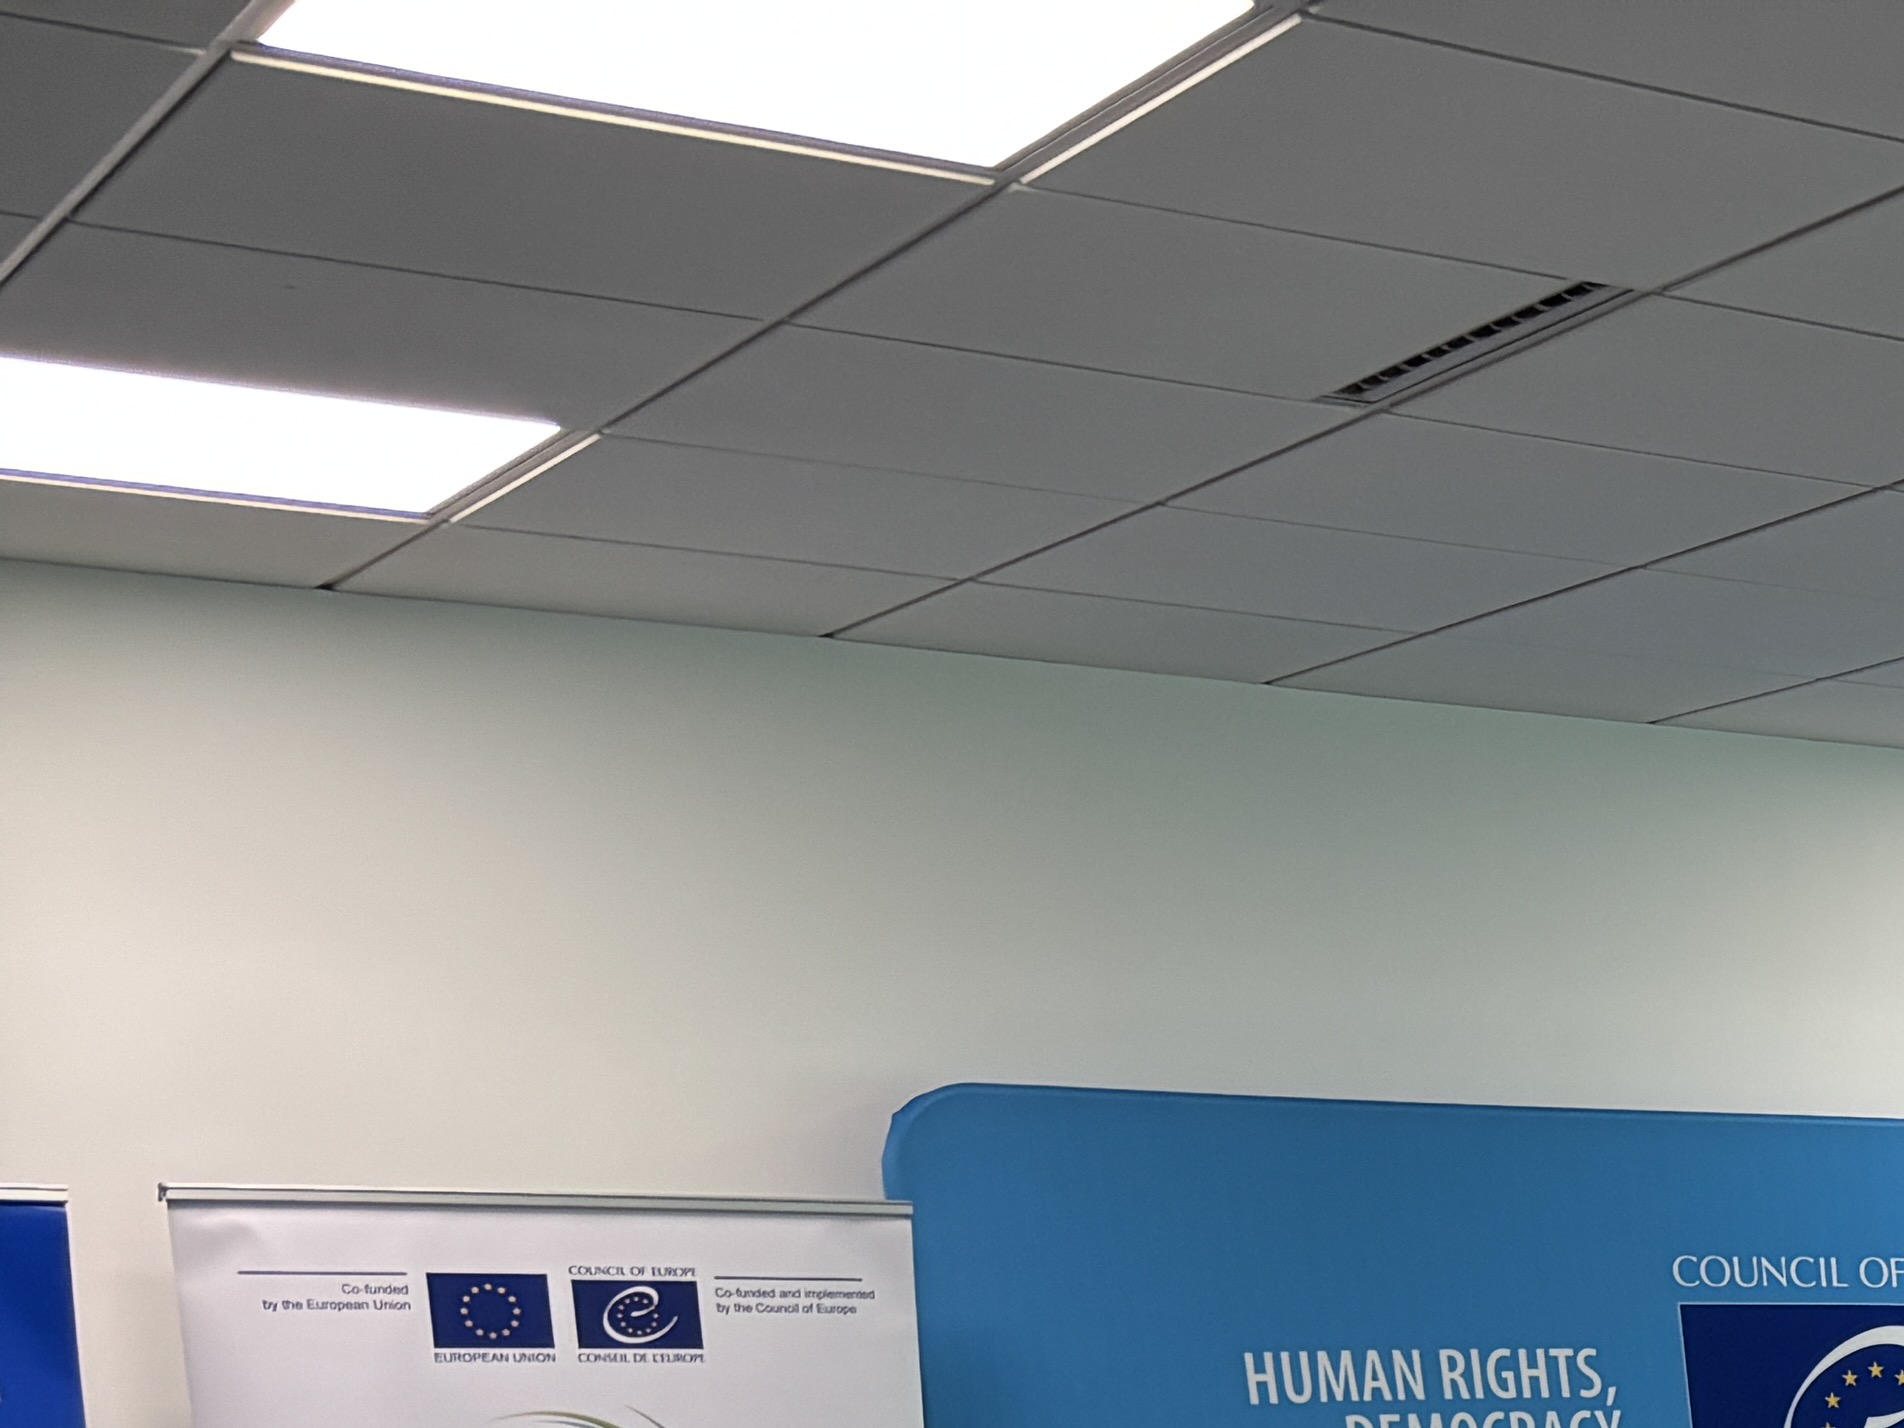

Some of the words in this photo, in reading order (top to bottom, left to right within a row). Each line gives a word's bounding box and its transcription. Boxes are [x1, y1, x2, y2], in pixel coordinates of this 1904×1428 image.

[1673, 1256, 1848, 1287] COUNCIL
[1860, 1257, 1904, 1287] OF
[342, 1283, 409, 1296] Co-funded
[715, 1287, 776, 1299] Co-funded
[779, 1288, 801, 1299] and
[803, 1288, 875, 1301] implemented
[262, 1299, 277, 1313] by
[282, 1299, 303, 1311] the
[306, 1299, 369, 1313] European
[373, 1299, 411, 1311] Union
[716, 1302, 731, 1315] by
[734, 1303, 753, 1314] the
[756, 1303, 800, 1314] Council
[802, 1303, 814, 1314] of
[816, 1304, 858, 1316] Europe
[434, 1352, 509, 1364] EUROPEAN
[513, 1352, 556, 1364] UNION
[1245, 1350, 1425, 1404] HUMAN
[1440, 1348, 1616, 1406] RIGHTS,
